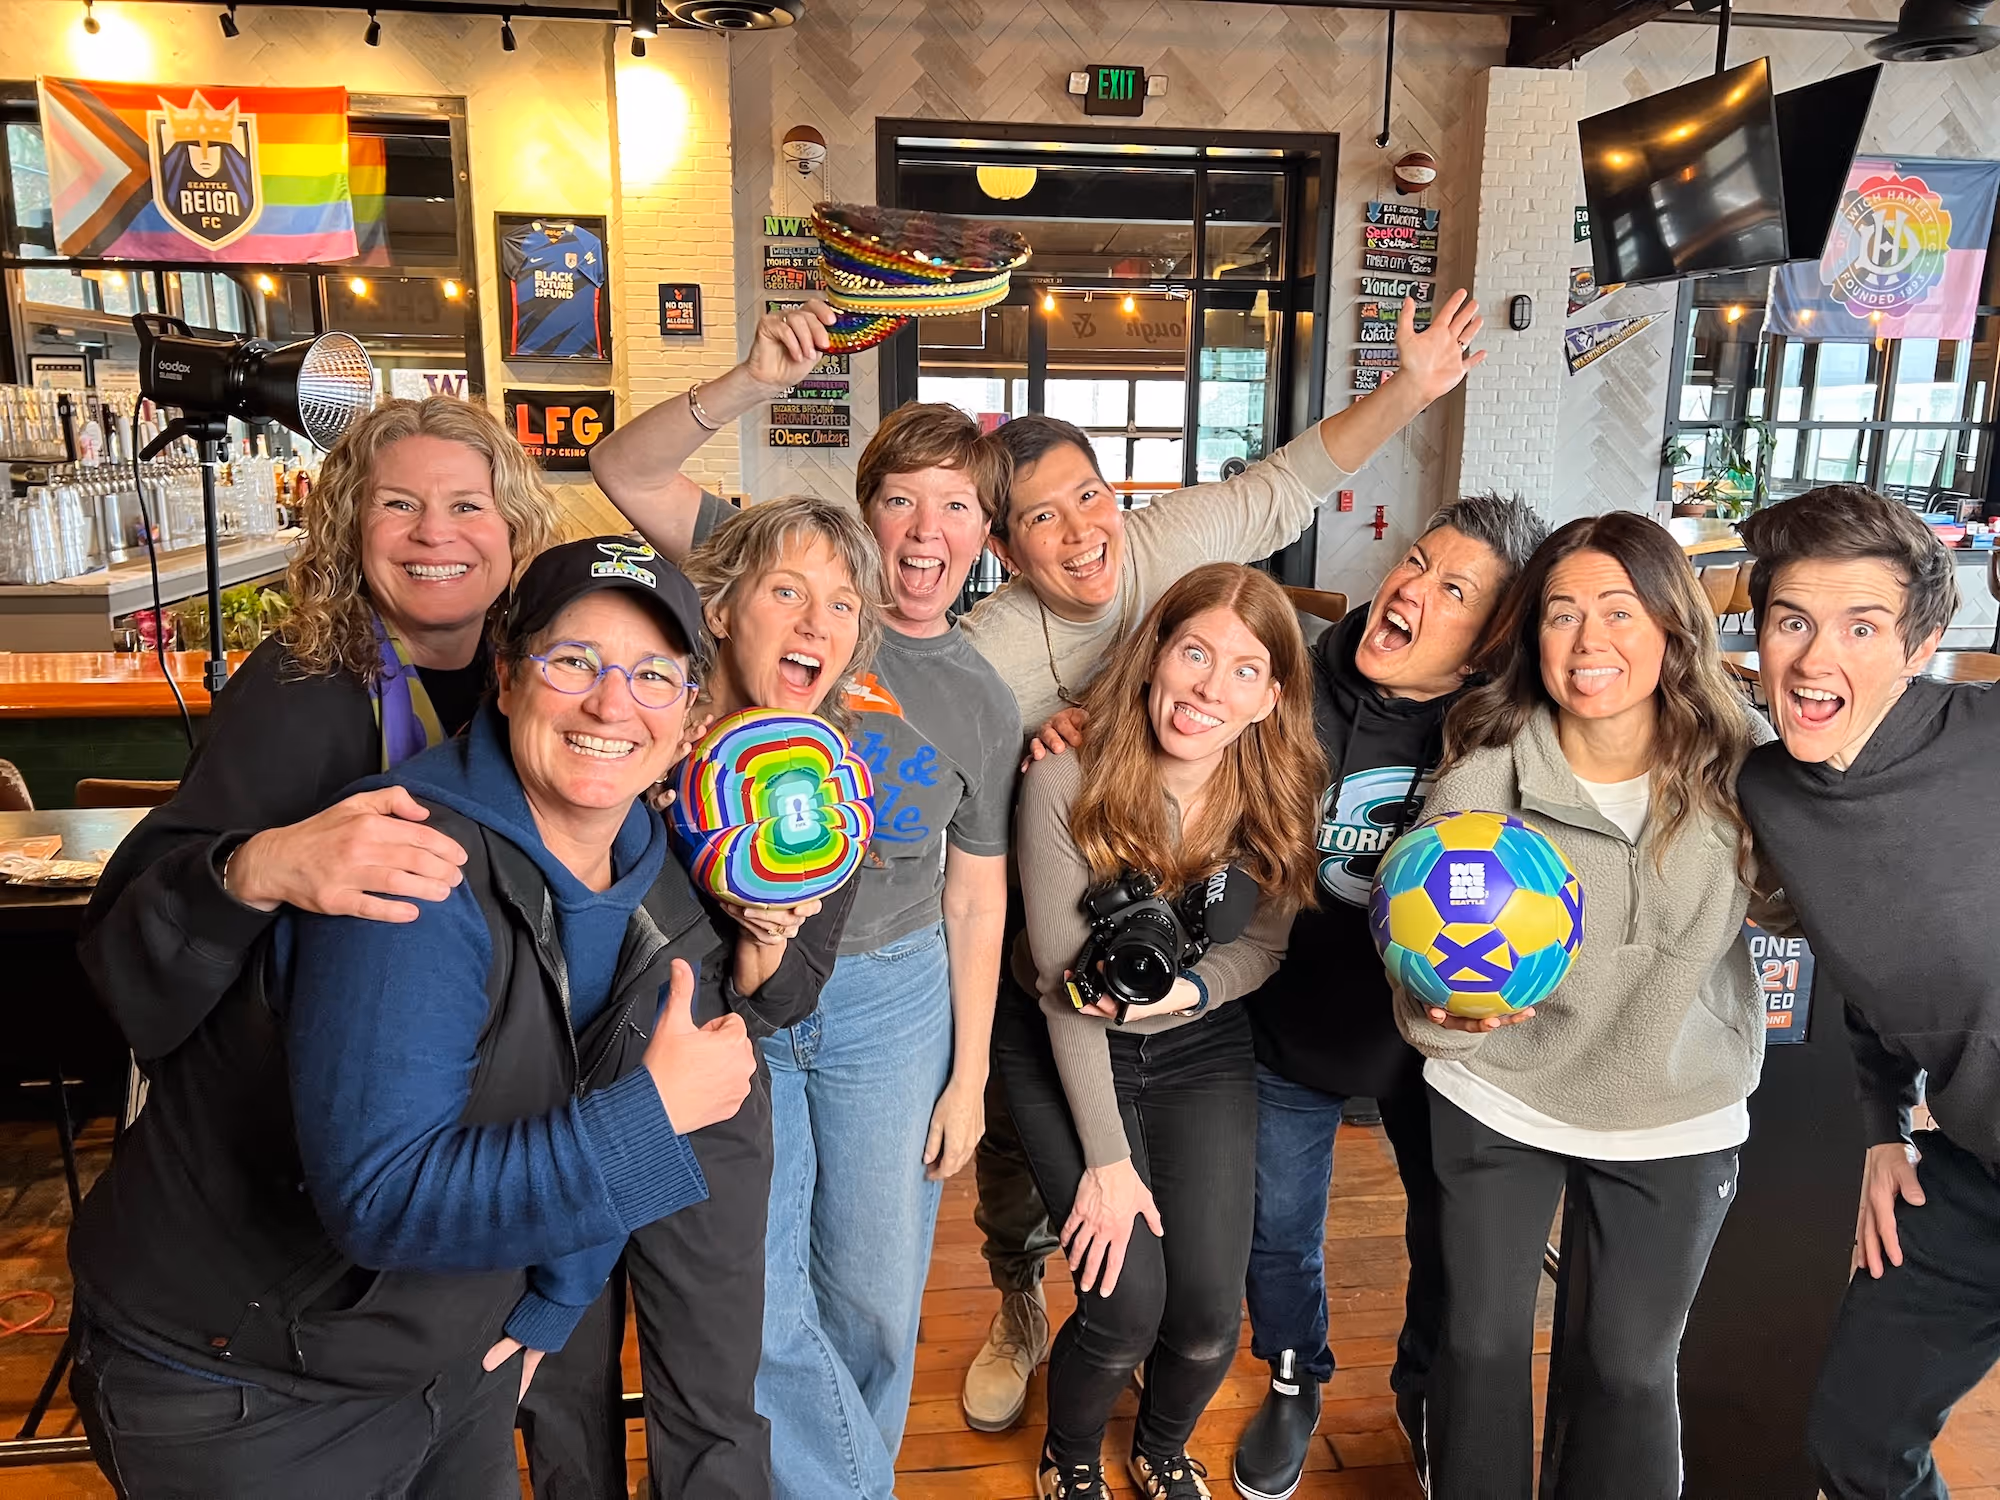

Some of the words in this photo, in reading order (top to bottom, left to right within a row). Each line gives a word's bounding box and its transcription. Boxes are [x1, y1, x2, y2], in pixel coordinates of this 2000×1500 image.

[1098, 68, 1136, 100] EXIT
[187, 181, 228, 189] SEATTLE
[180, 189, 240, 216] REIGN
[1887, 190, 1934, 224] HAMLET
[201, 216, 222, 229] FC
[764, 216, 801, 236] NW
[1366, 254, 1389, 268] TIMBER
[1389, 257, 1406, 270] CITY
[534, 270, 574, 282] BLACK
[534, 280, 574, 291] FUTURE
[543, 288, 574, 299] FUND
[1361, 277, 1418, 297] Yonder
[1840, 271, 1896, 305] FOUNDED
[665, 301, 677, 309] NO
[677, 301, 694, 310] ONE
[681, 309, 694, 318] 21
[1571, 334, 1621, 370] WASHINGTON
[158, 360, 191, 374] Godox
[1356, 369, 1380, 377] FROM
[423, 374, 467, 399] W
[1354, 381, 1378, 389] TANK
[772, 405, 801, 413] BIZARRE
[802, 405, 834, 414] BREWING
[516, 403, 603, 446] LFG
[774, 413, 810, 425] BROWN
[810, 414, 848, 426] PORTER
[774, 429, 811, 445] Obec
[1204, 864, 1230, 909] ØDE
[1751, 935, 1802, 957] ONE
[1760, 959, 1799, 991] 21
